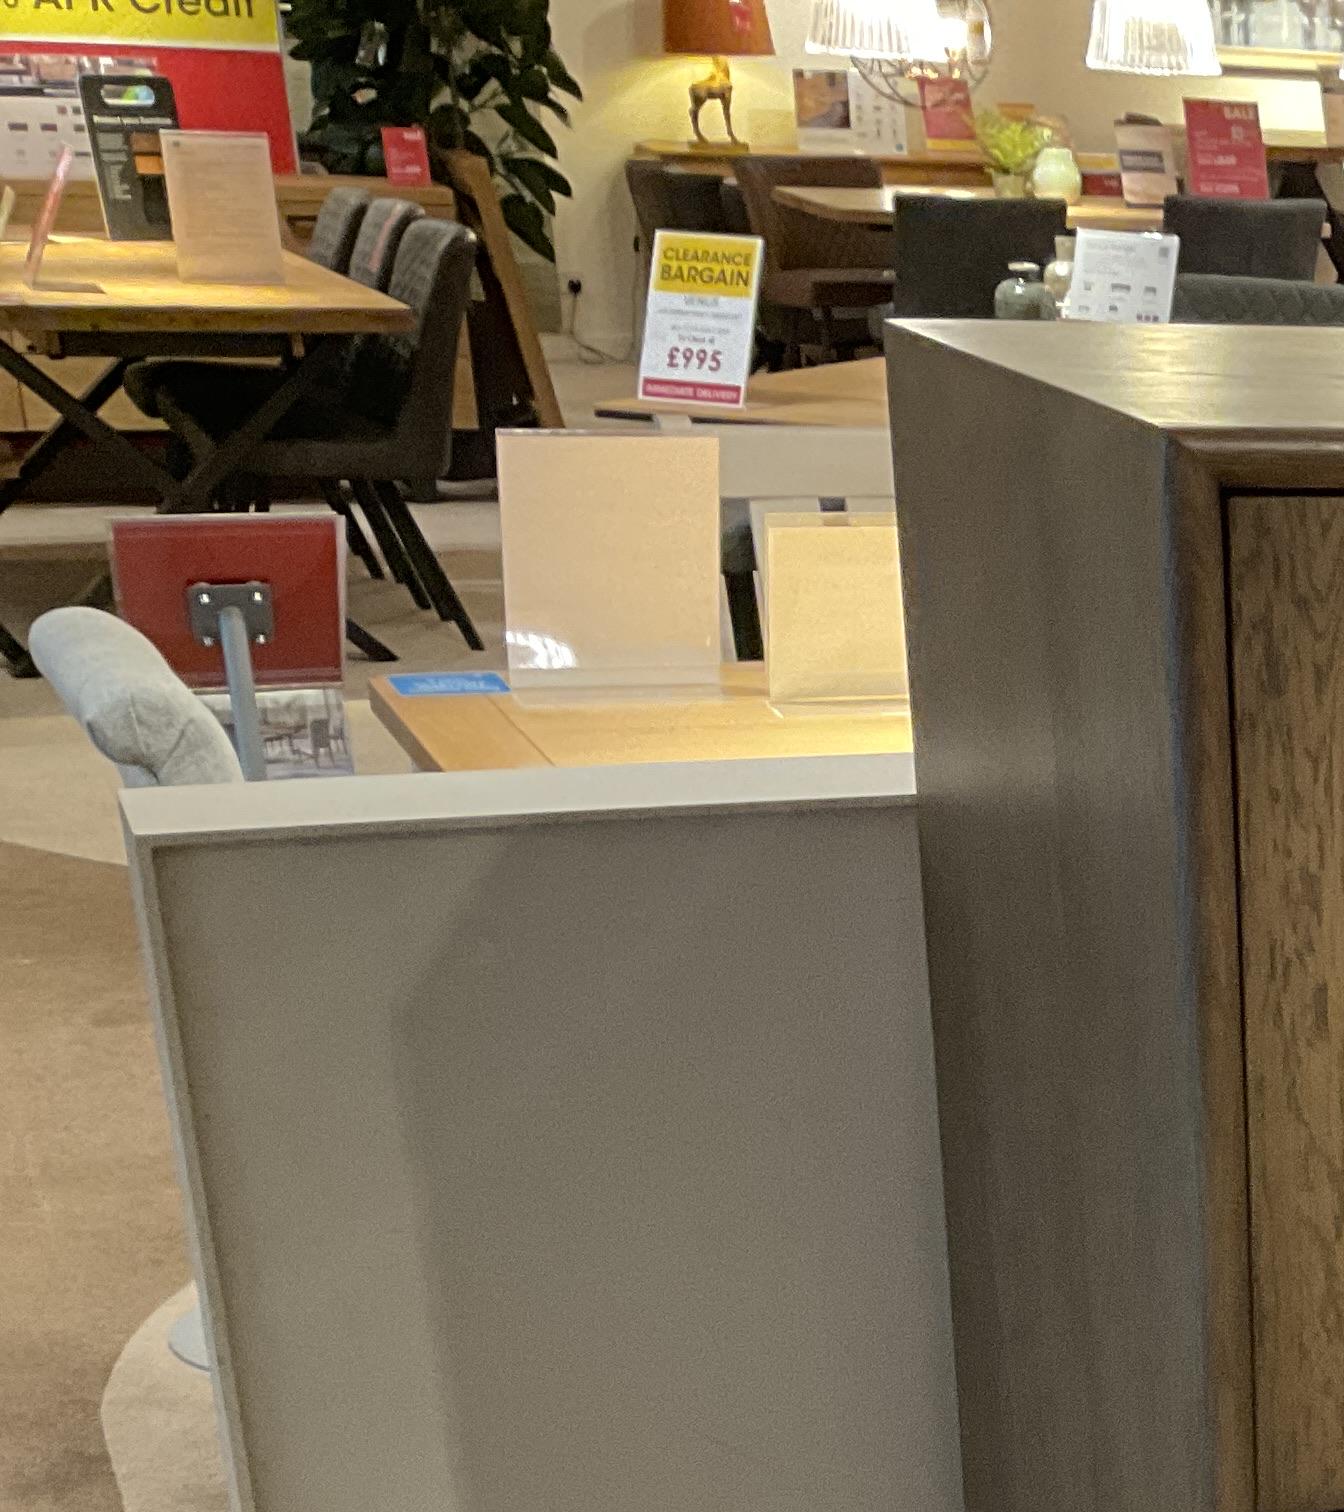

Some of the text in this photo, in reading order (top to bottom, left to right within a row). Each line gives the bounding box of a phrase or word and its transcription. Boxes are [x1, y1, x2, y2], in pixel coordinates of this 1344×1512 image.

[663, 247, 753, 267] CLEARANCE
[660, 264, 750, 287] BARGAIN
[667, 346, 723, 372] £995
